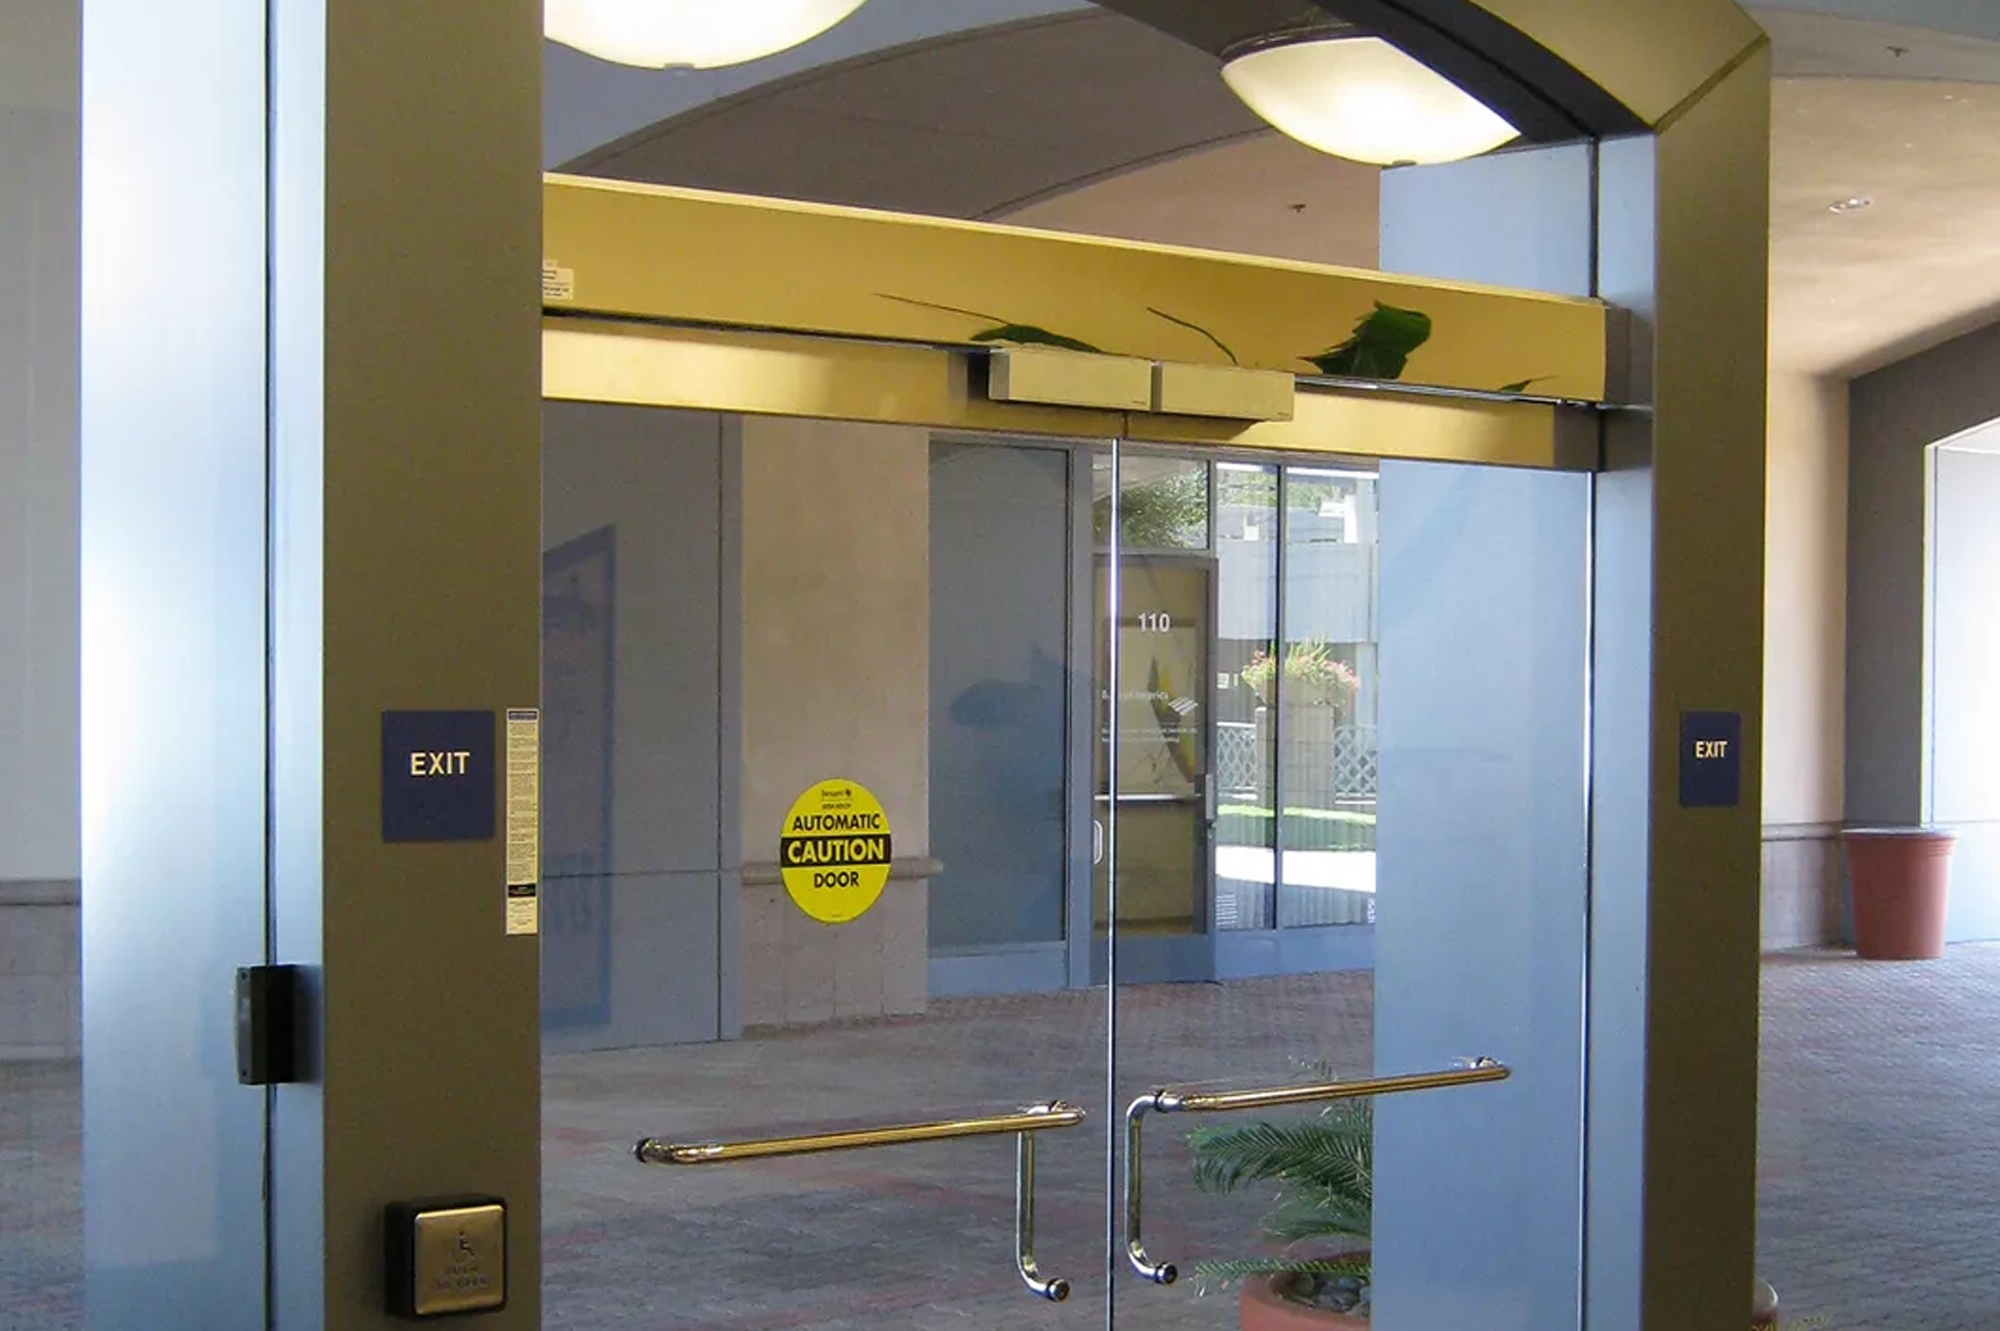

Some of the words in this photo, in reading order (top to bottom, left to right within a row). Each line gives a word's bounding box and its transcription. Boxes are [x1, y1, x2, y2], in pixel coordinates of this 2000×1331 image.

[1138, 612, 1171, 633] 110
[1695, 740, 1728, 758] EXIT
[410, 751, 470, 776] EXIT
[792, 813, 881, 831] AUTOMATIC
[787, 838, 884, 864] CAUTION
[814, 871, 860, 889] DOOR
